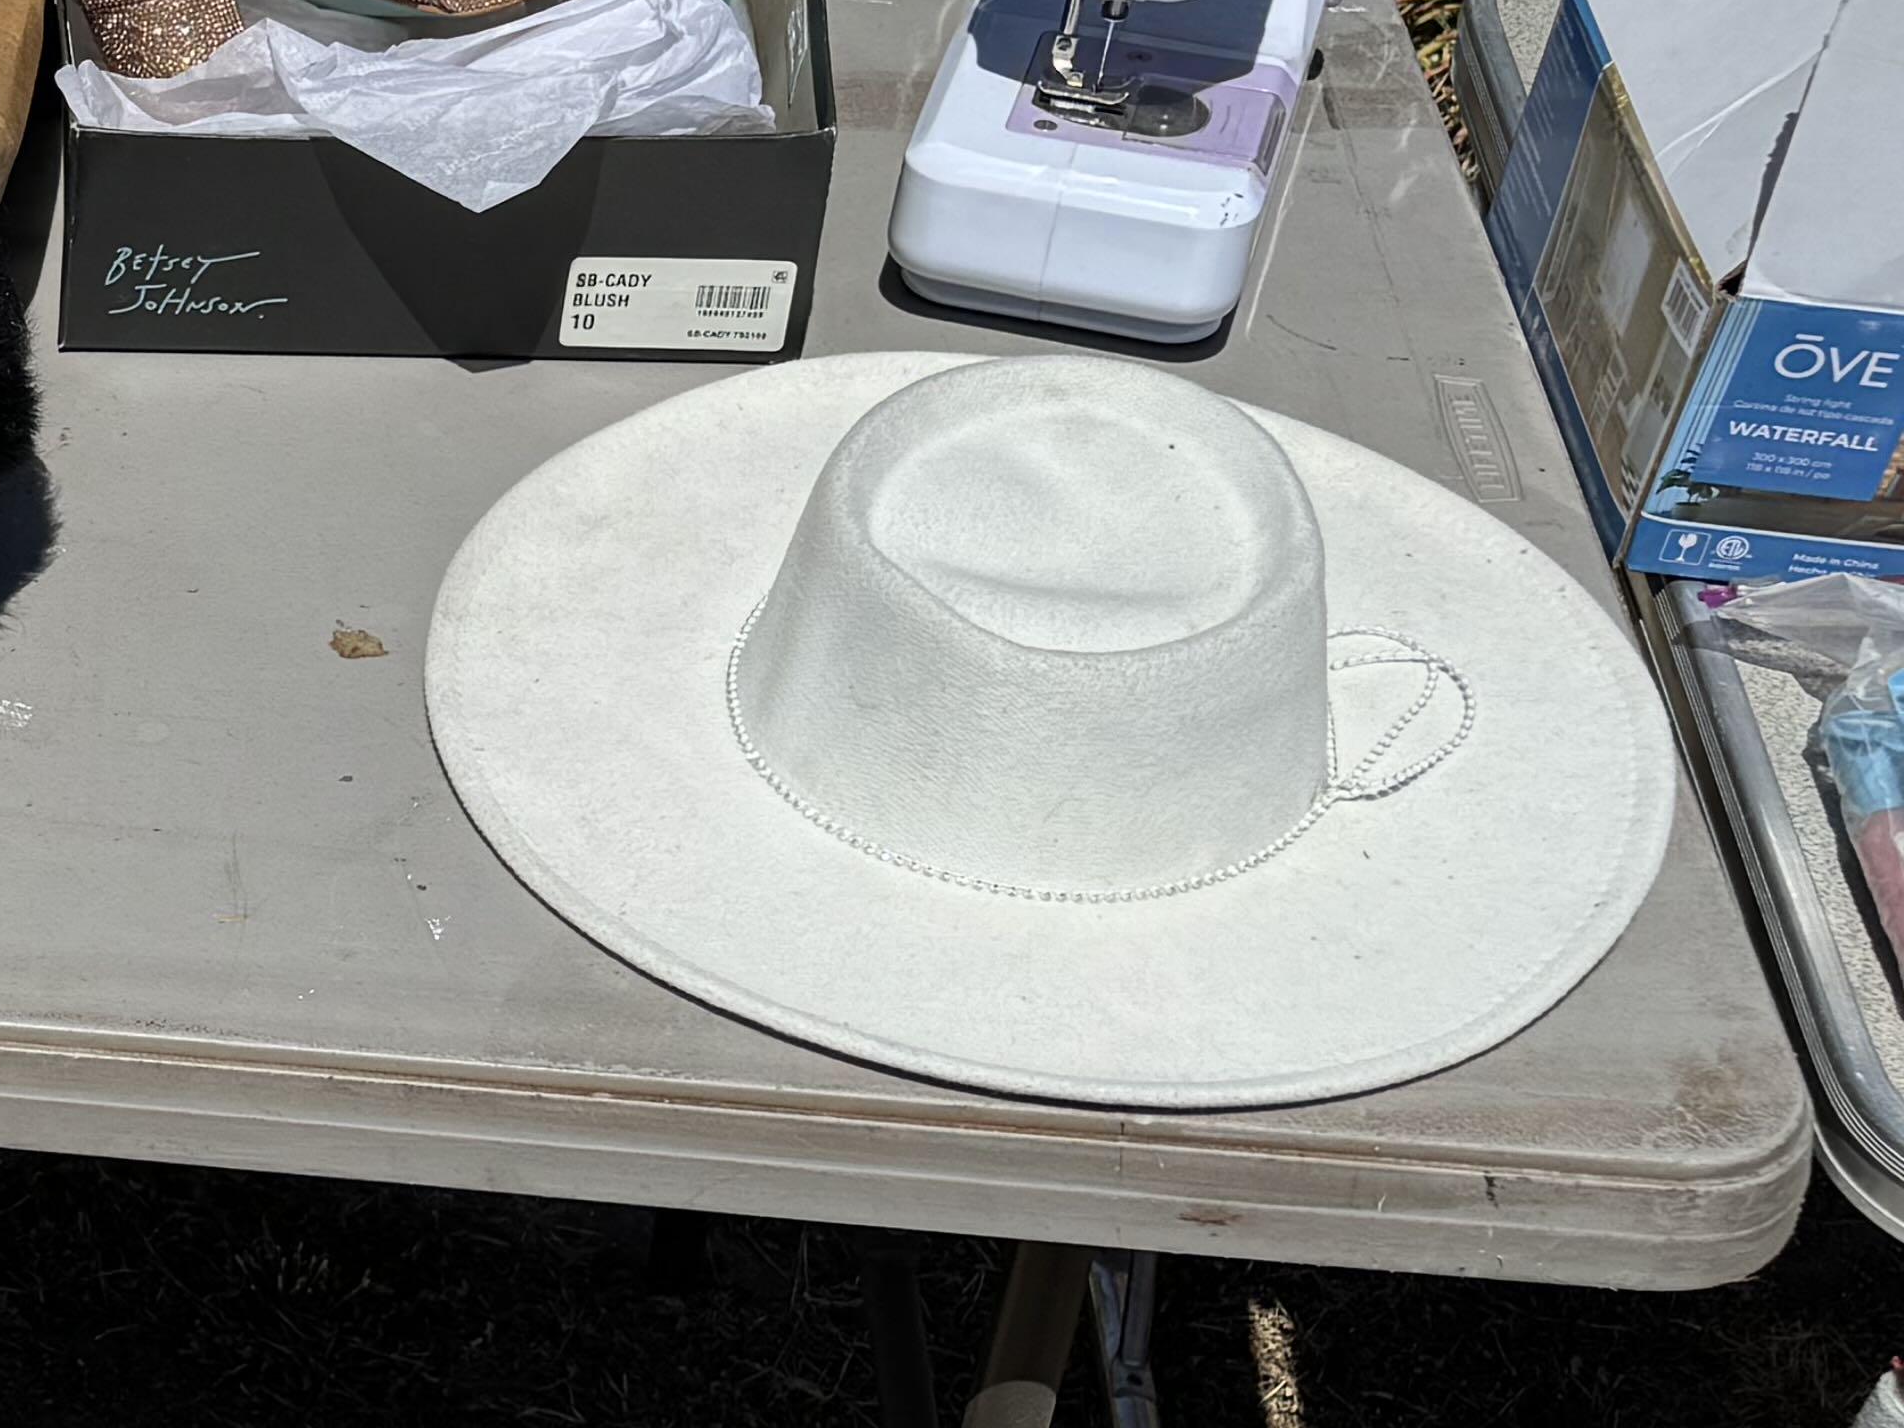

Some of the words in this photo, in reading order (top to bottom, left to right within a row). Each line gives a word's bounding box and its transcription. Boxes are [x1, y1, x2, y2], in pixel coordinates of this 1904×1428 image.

[575, 273, 652, 288] SB-CADY
[572, 293, 630, 308] BLUSH
[571, 313, 595, 330] 10
[1824, 397, 1853, 410] light
[1729, 420, 1880, 453] WATERFALL
[1792, 552, 1827, 565] Made
[1830, 556, 1841, 566] in
[1844, 558, 1880, 570] China
